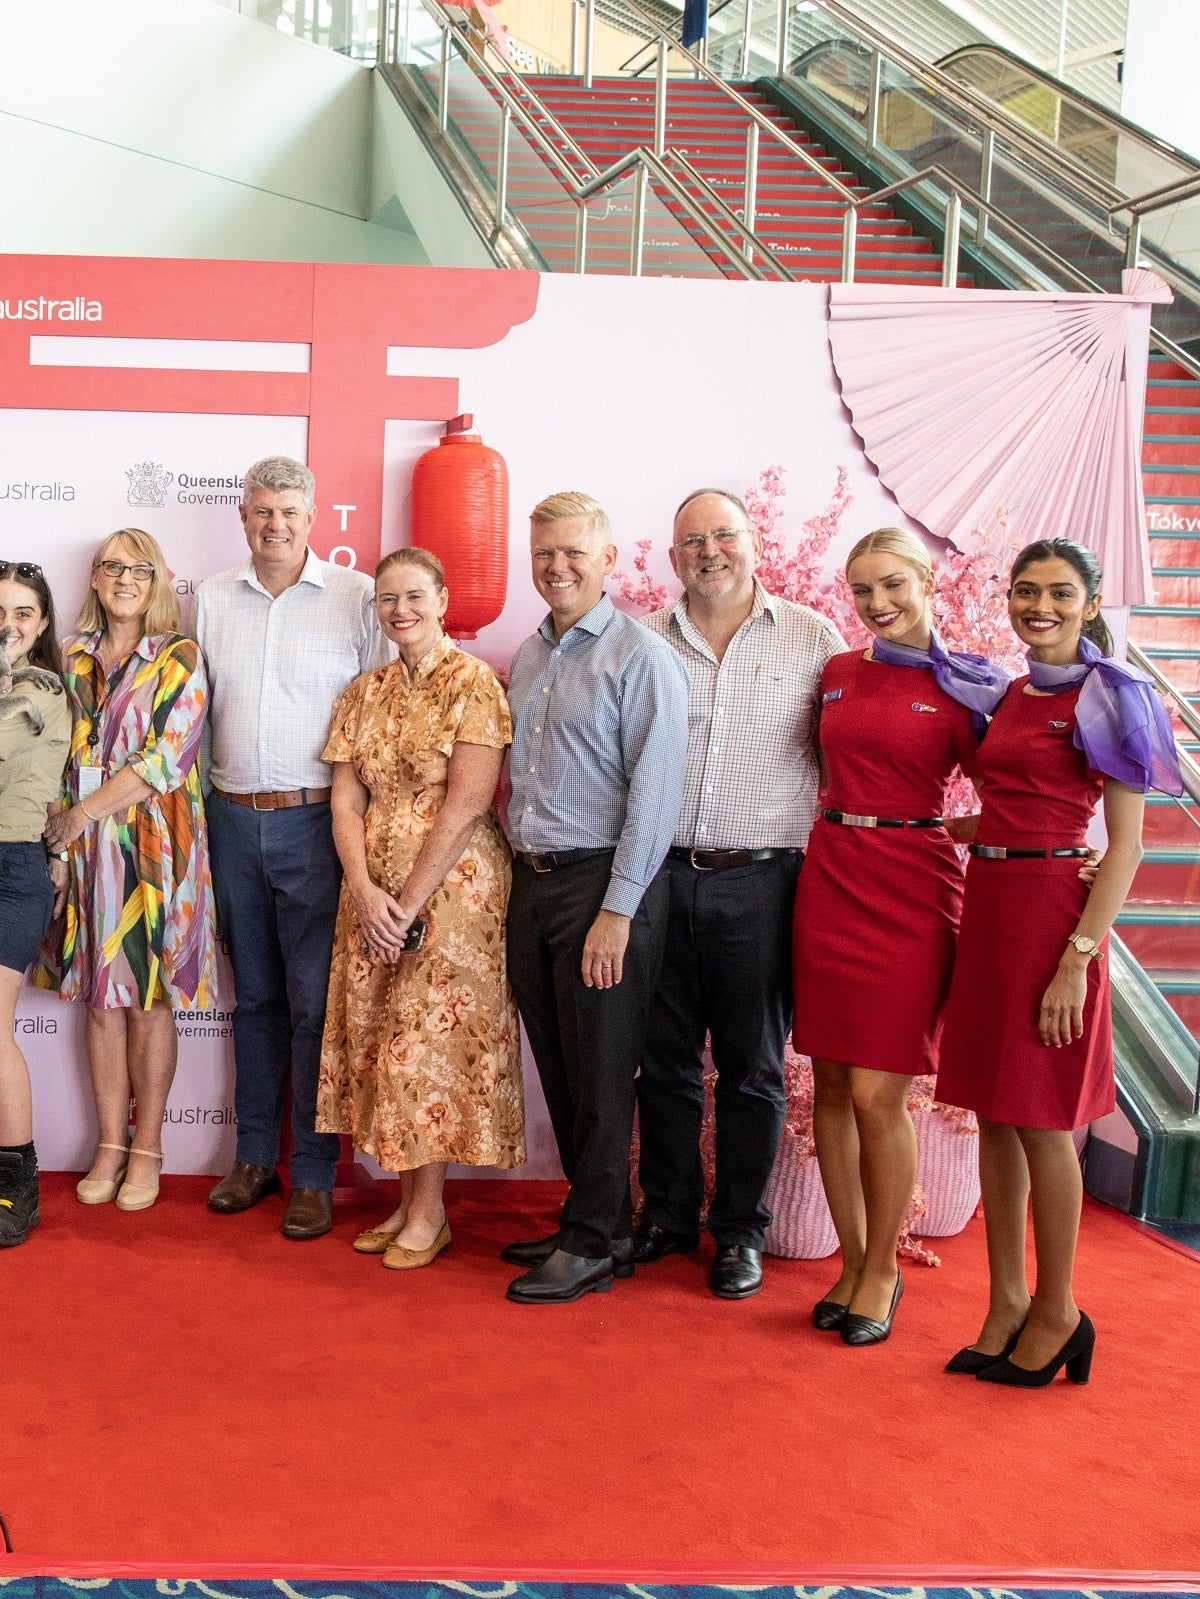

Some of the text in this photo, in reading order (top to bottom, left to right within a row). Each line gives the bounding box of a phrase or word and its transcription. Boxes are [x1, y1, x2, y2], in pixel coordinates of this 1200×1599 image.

[178, 473, 244, 489] Queensla
[177, 490, 241, 505] Governm
[1146, 511, 1200, 532] Toky
[14, 1015, 57, 1034] ralia
